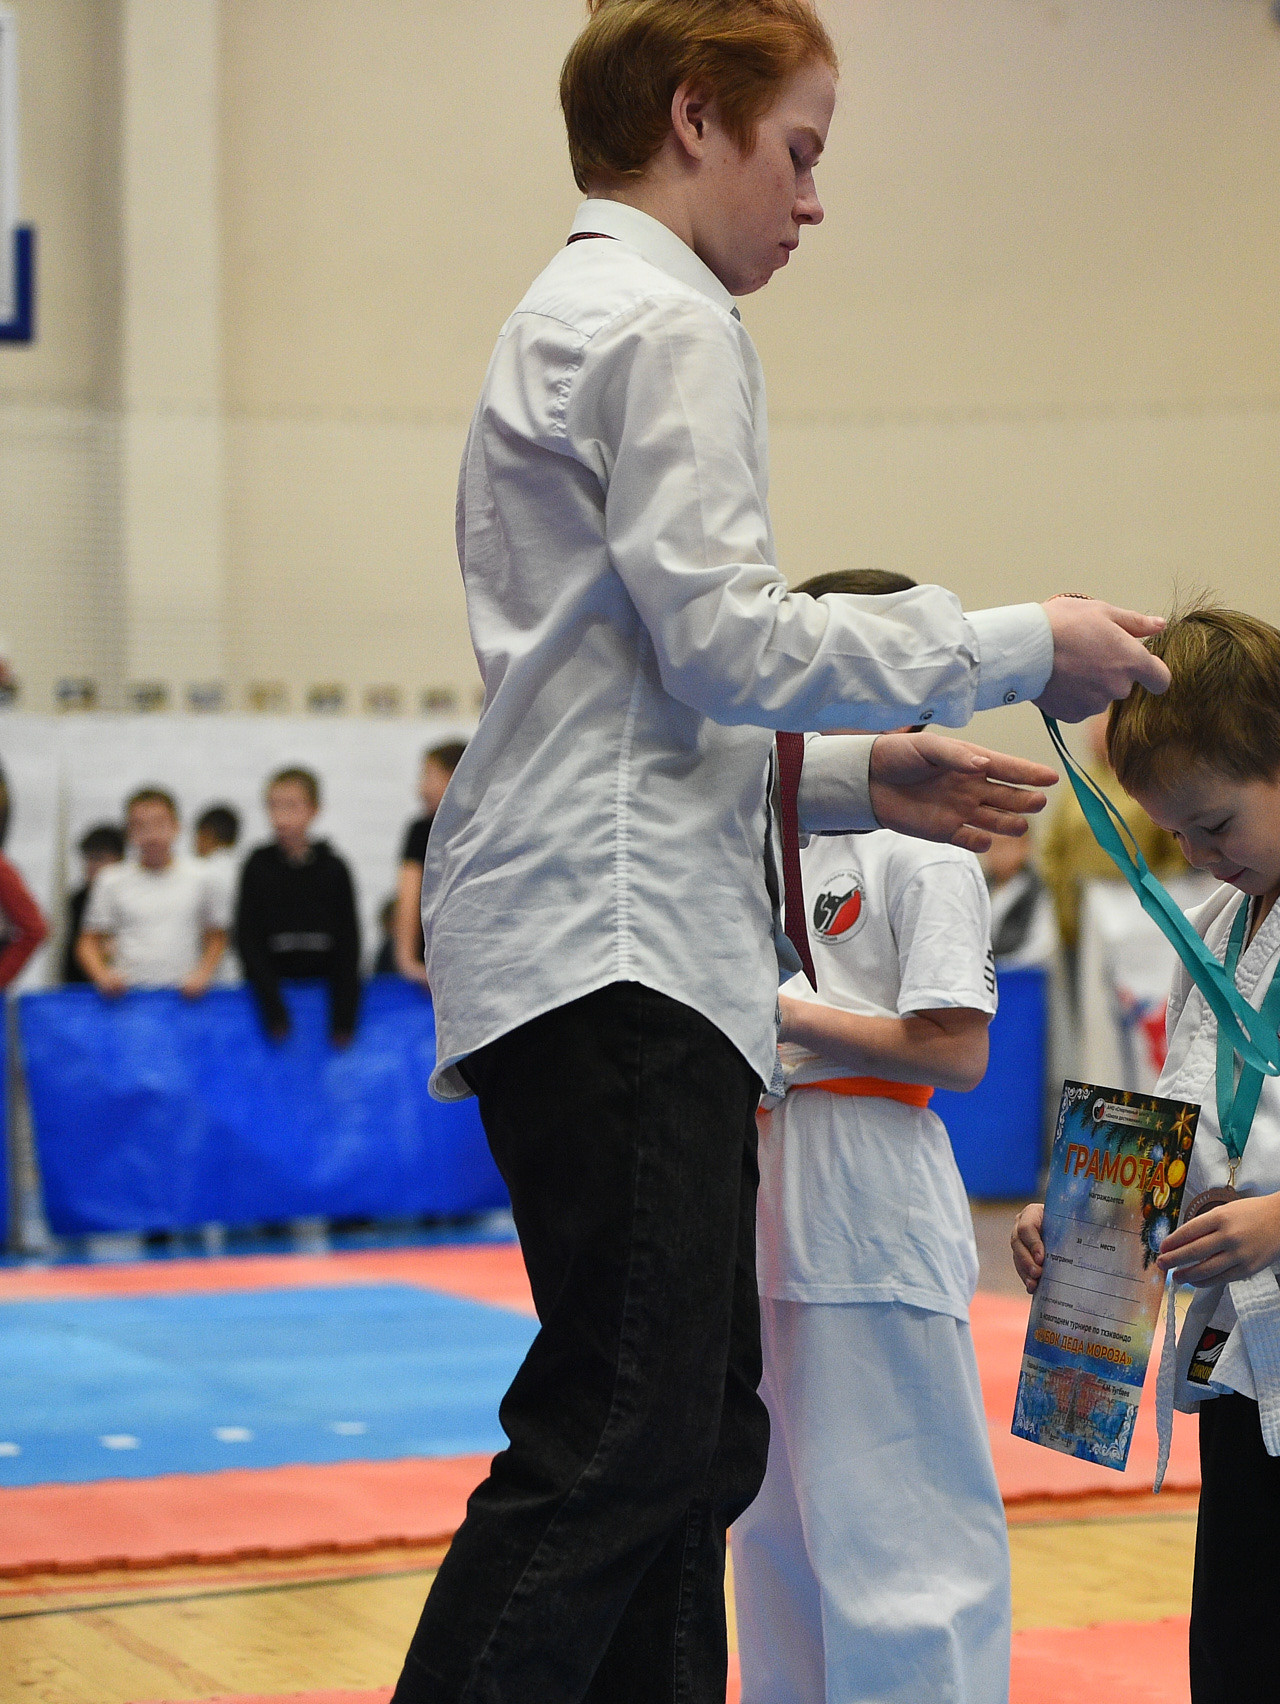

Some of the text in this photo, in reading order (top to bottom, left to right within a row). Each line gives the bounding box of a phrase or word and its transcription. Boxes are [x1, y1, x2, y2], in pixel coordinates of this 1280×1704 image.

[1064, 1142, 1165, 1194] ГРАМОТА
[1070, 1320, 1092, 1333] турнире
[1092, 1327, 1100, 1335] по
[1100, 1329, 1132, 1343] тхэквондо
[1061, 1335, 1085, 1354] ДЕДА
[1086, 1342, 1132, 1365] МОРОЗА»
